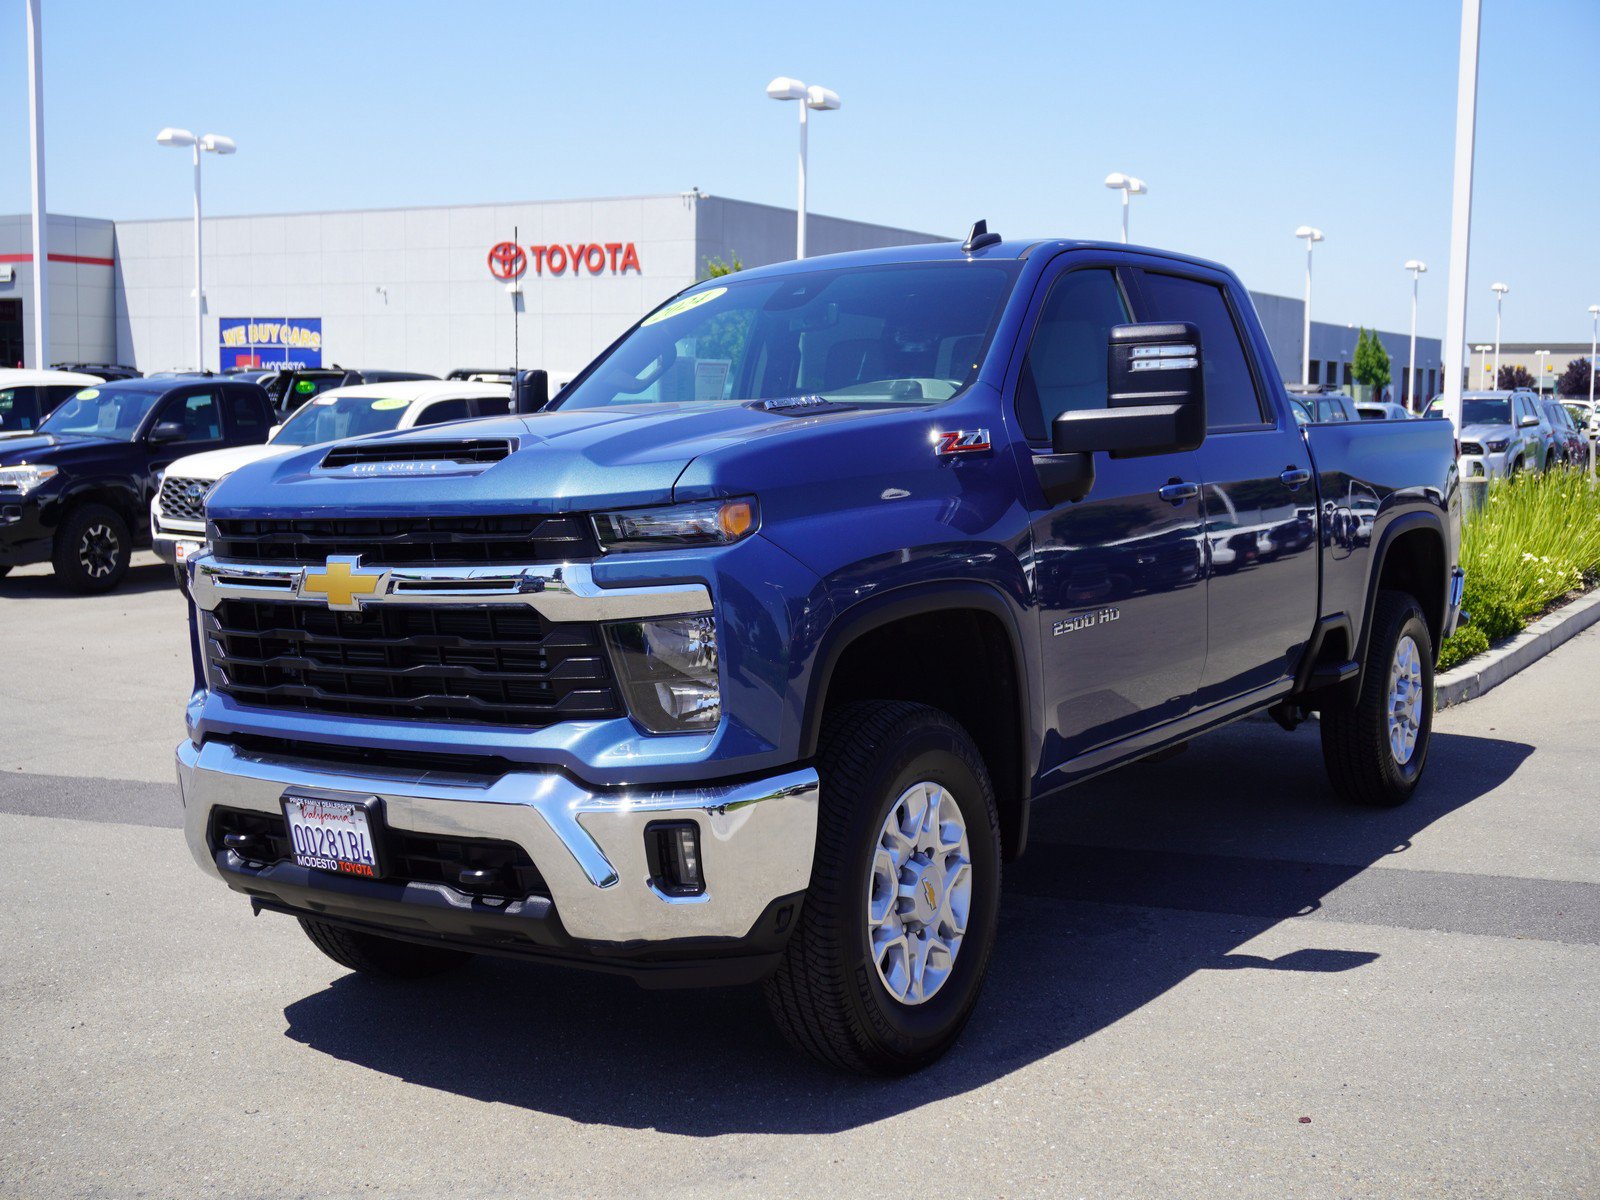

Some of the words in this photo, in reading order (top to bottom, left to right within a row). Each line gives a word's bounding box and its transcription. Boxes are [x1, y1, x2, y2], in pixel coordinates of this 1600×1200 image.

[530, 243, 640, 274] TOYOTA
[222, 326, 246, 347] WE
[248, 323, 280, 343] BUY
[280, 325, 320, 351] CARS
[261, 361, 306, 371] MODESTO
[932, 428, 991, 456] Z71
[1053, 613, 1095, 636] 2500
[1099, 607, 1120, 624] HD
[301, 803, 355, 826] California
[294, 824, 373, 864] 00281B4
[296, 855, 338, 871] MODESTO
[338, 860, 374, 877] TOYOTA
